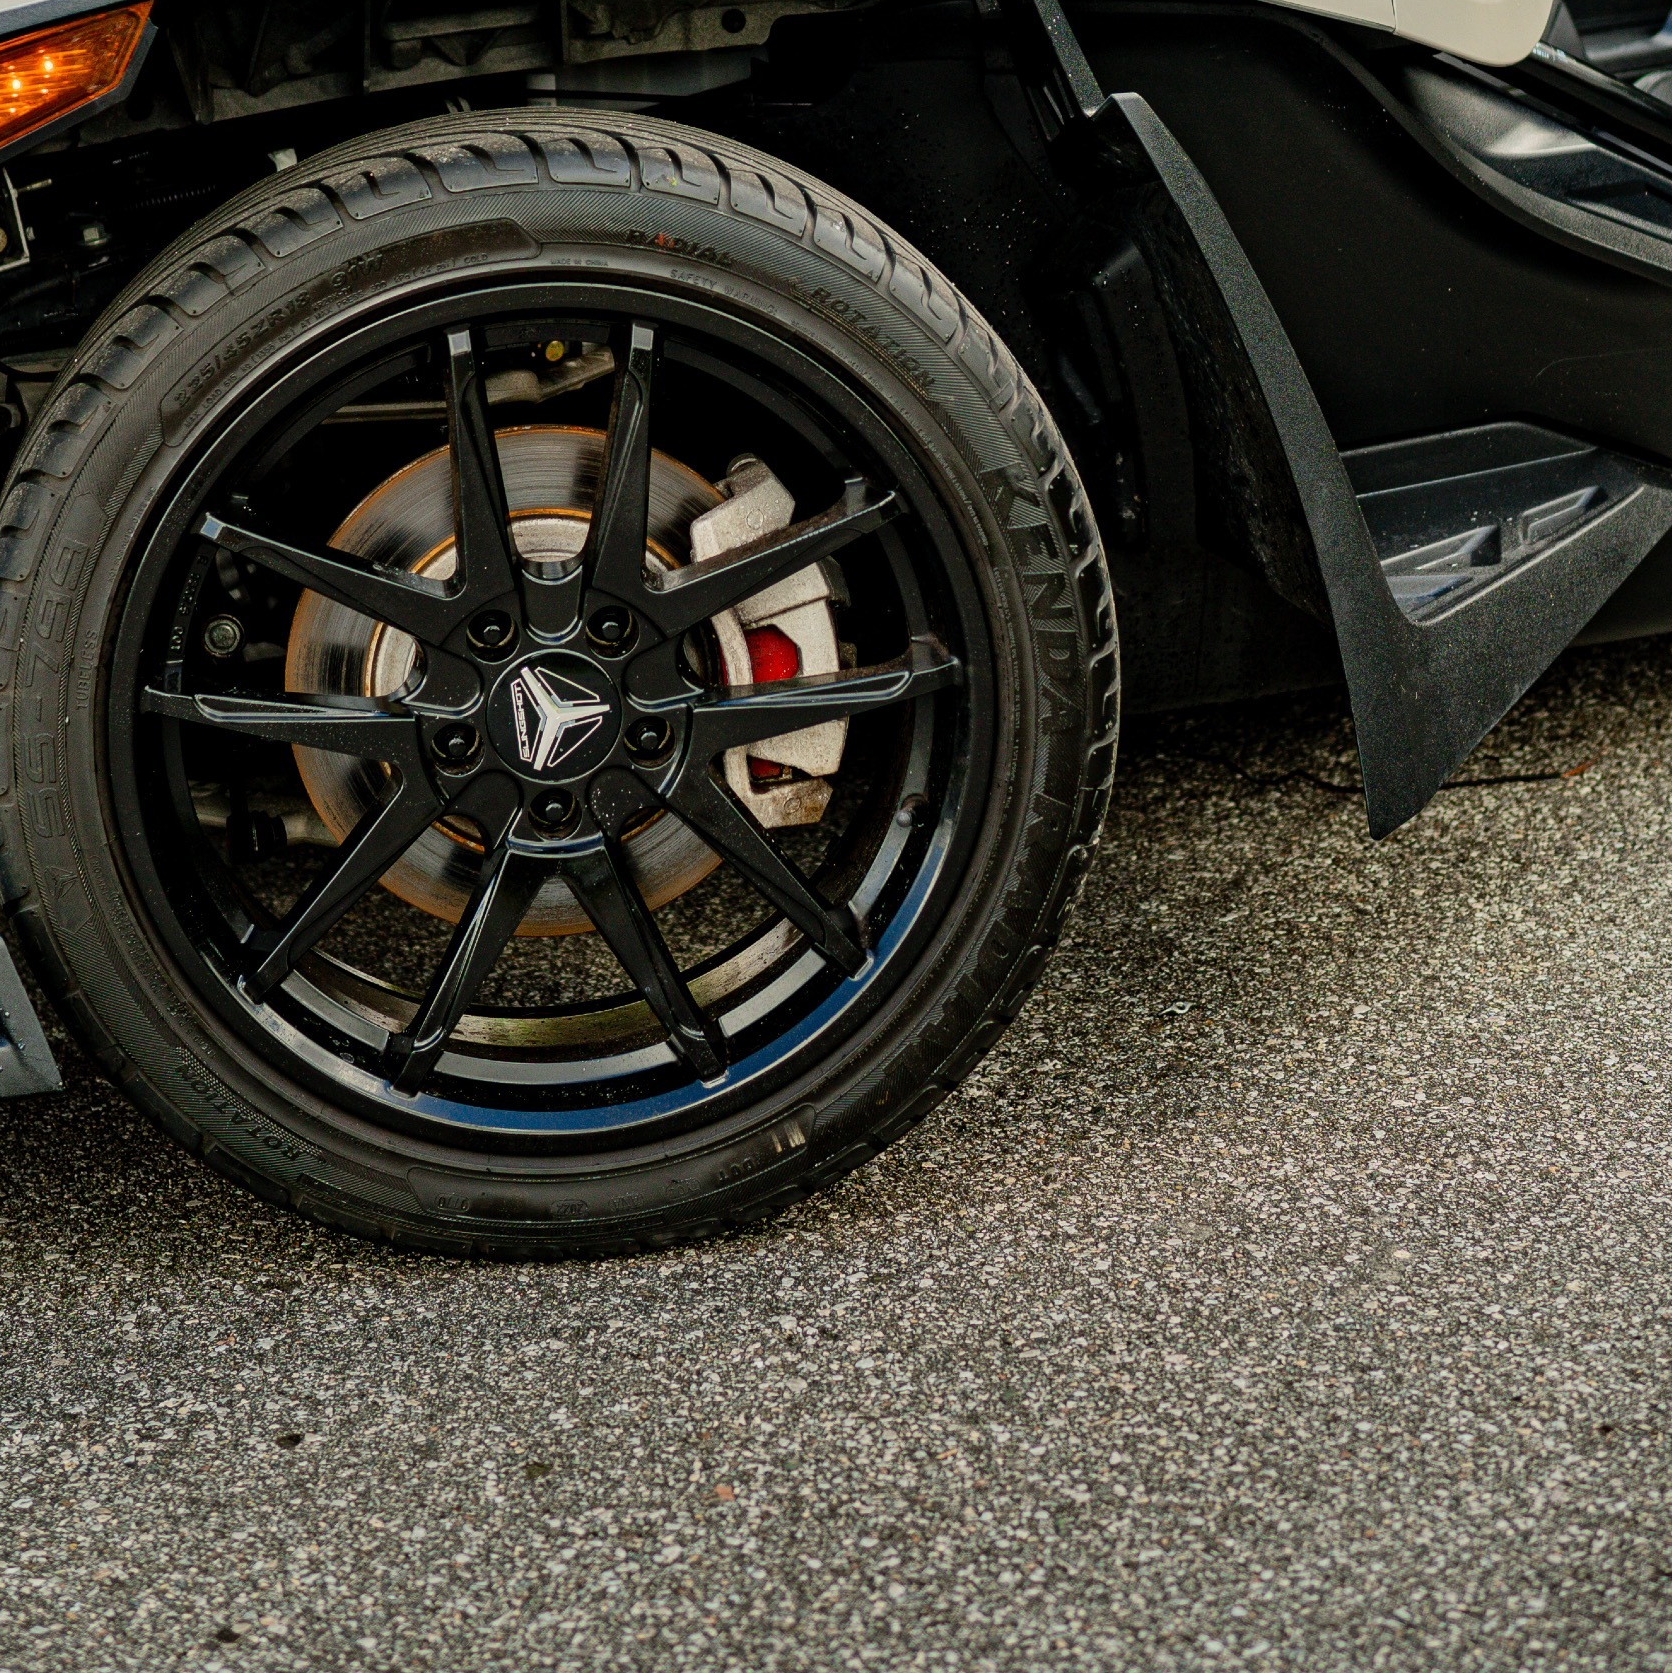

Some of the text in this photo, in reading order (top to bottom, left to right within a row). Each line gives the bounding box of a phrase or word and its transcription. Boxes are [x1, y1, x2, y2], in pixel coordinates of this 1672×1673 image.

[669, 268, 718, 291] SAFETY
[810, 285, 935, 388] ROTATION
[979, 461, 1083, 732] KENDA
[77, 630, 98, 709] TUBELESS
[513, 685, 530, 758] SLINGSHOT
[882, 791, 1072, 1081] RADIAL
[177, 1063, 302, 1160] ROTATION
